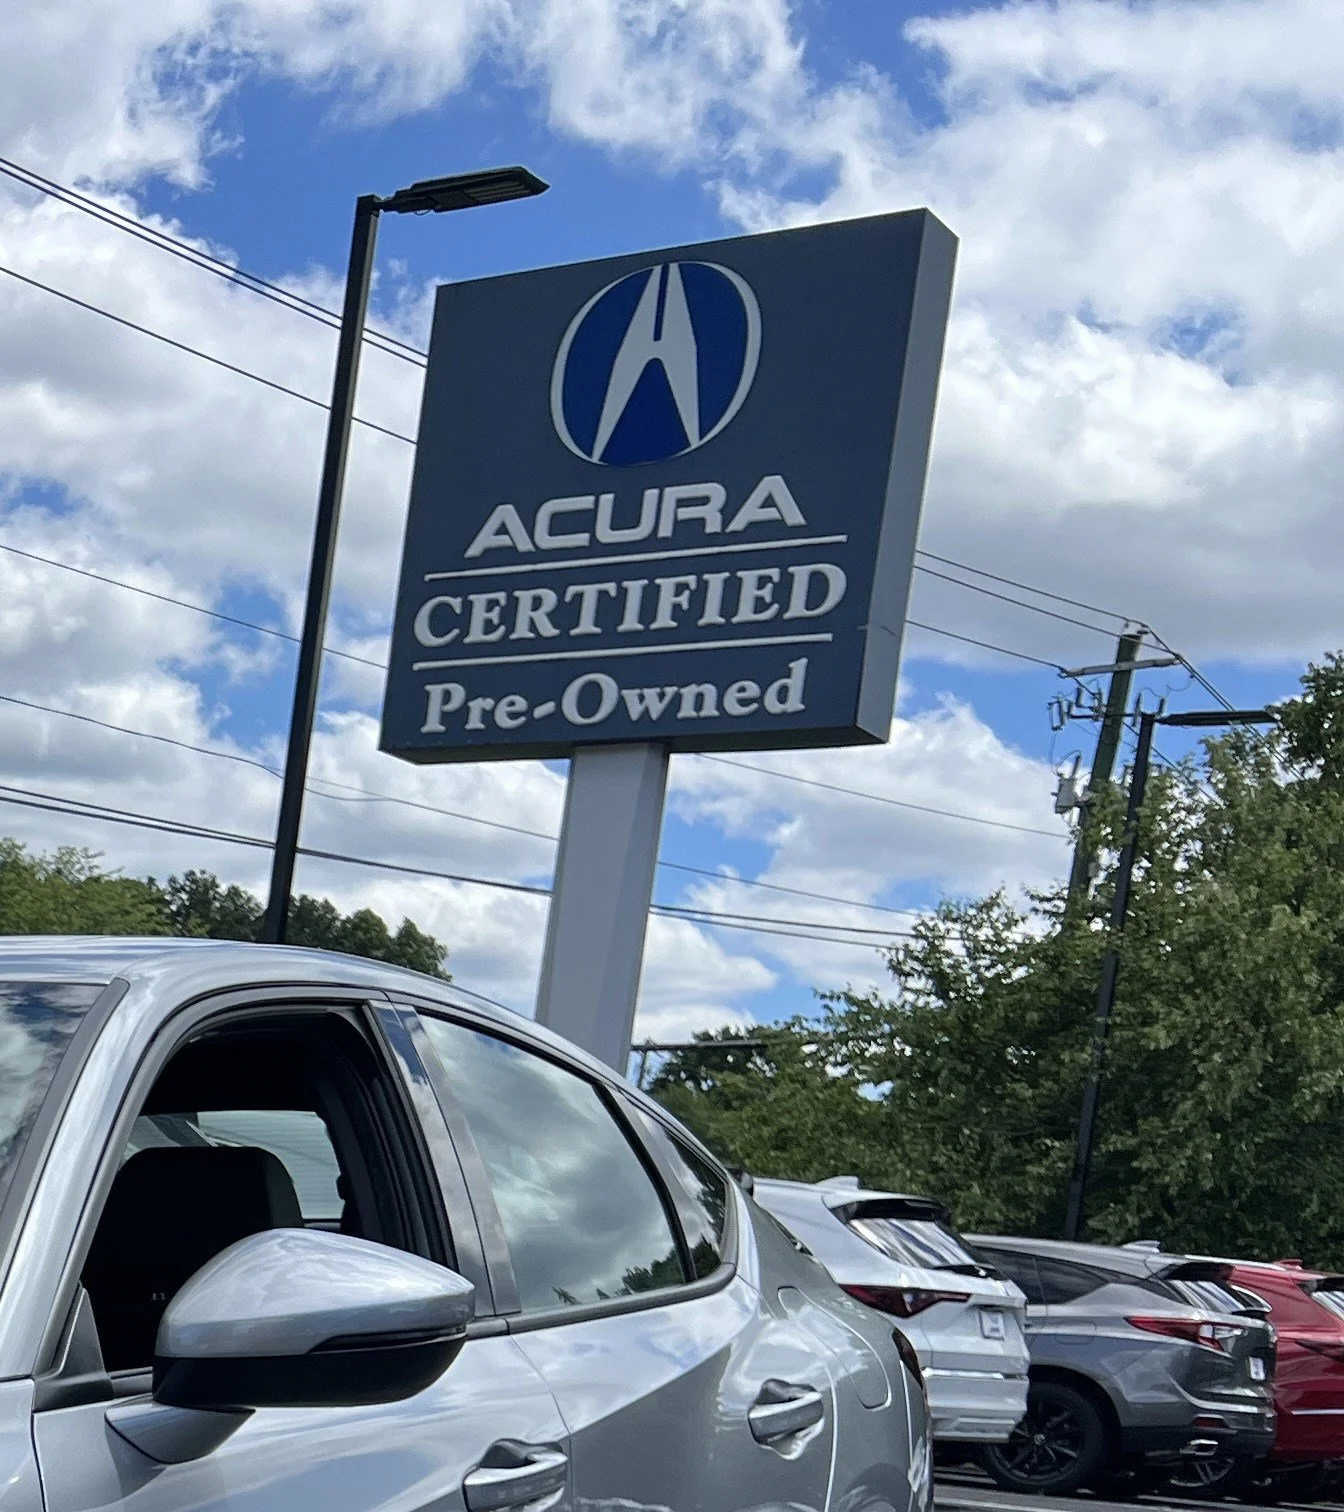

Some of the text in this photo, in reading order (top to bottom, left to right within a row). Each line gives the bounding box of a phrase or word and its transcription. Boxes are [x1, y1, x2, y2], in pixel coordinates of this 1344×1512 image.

[463, 474, 807, 559] ACURA
[413, 562, 847, 649] CERTIFIED
[420, 657, 809, 734] Pre-Owned
